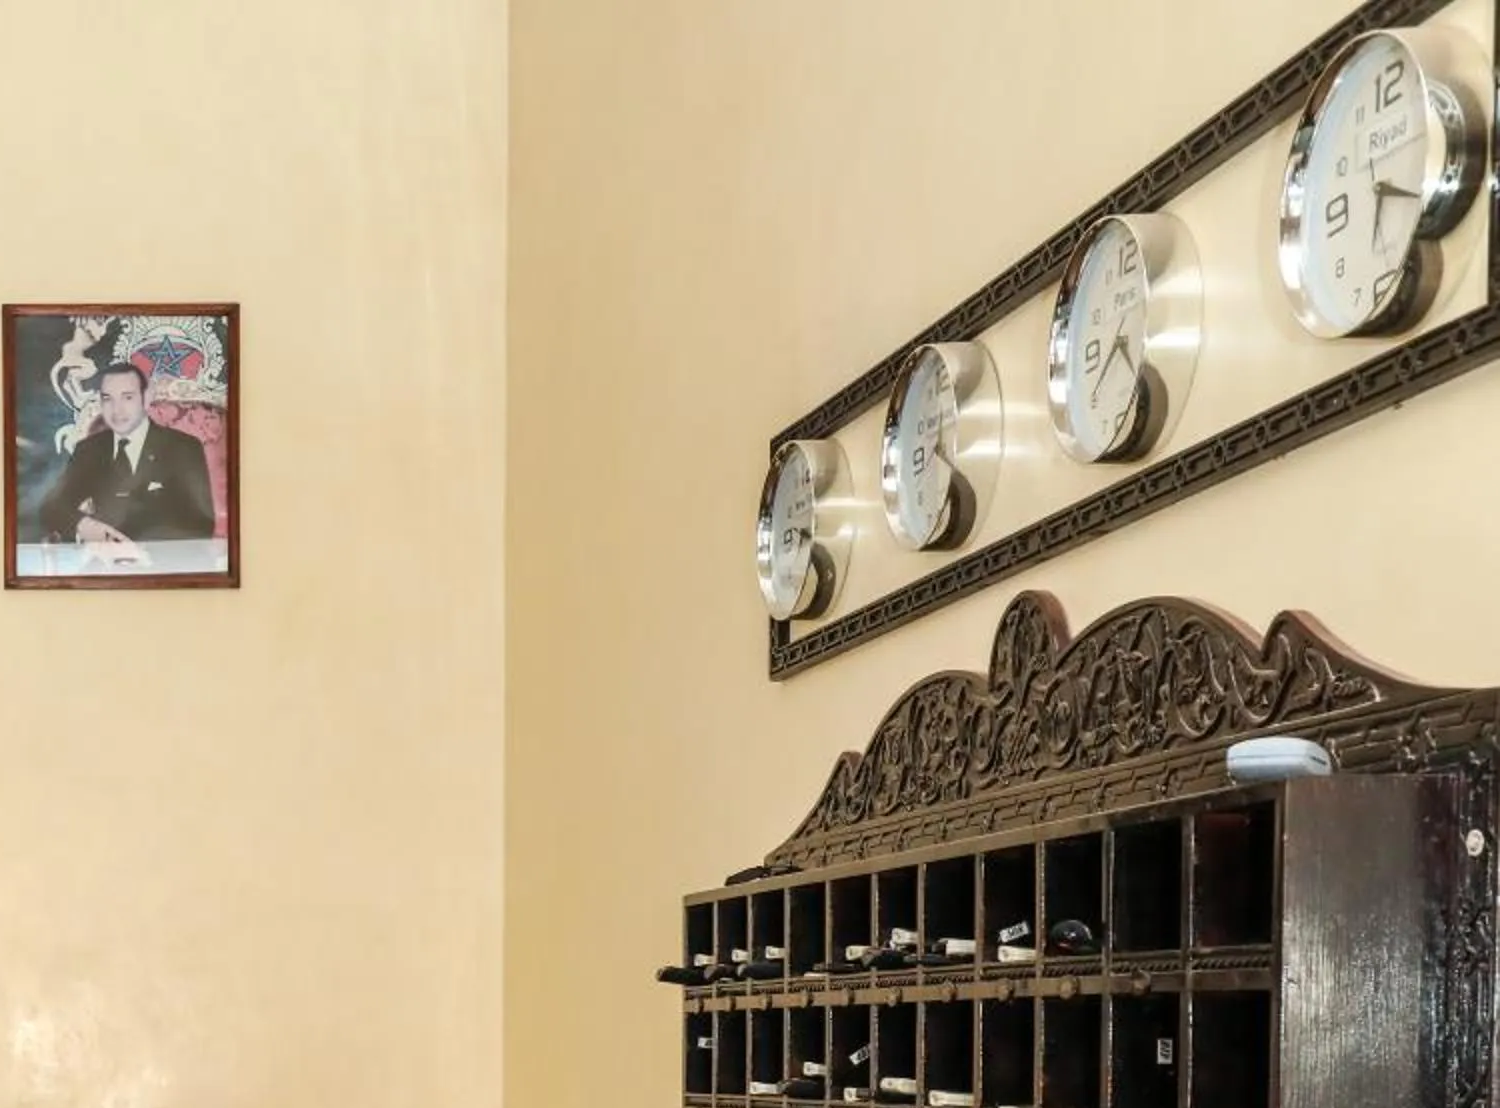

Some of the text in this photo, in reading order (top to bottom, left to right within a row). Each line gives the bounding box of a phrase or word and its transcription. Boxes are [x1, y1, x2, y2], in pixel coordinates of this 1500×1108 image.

[1375, 60, 1404, 113] 12
[1368, 116, 1407, 153] Riyad
[1326, 192, 1349, 238] 9
[1118, 239, 1138, 278] 12
[1085, 339, 1100, 374] 9
